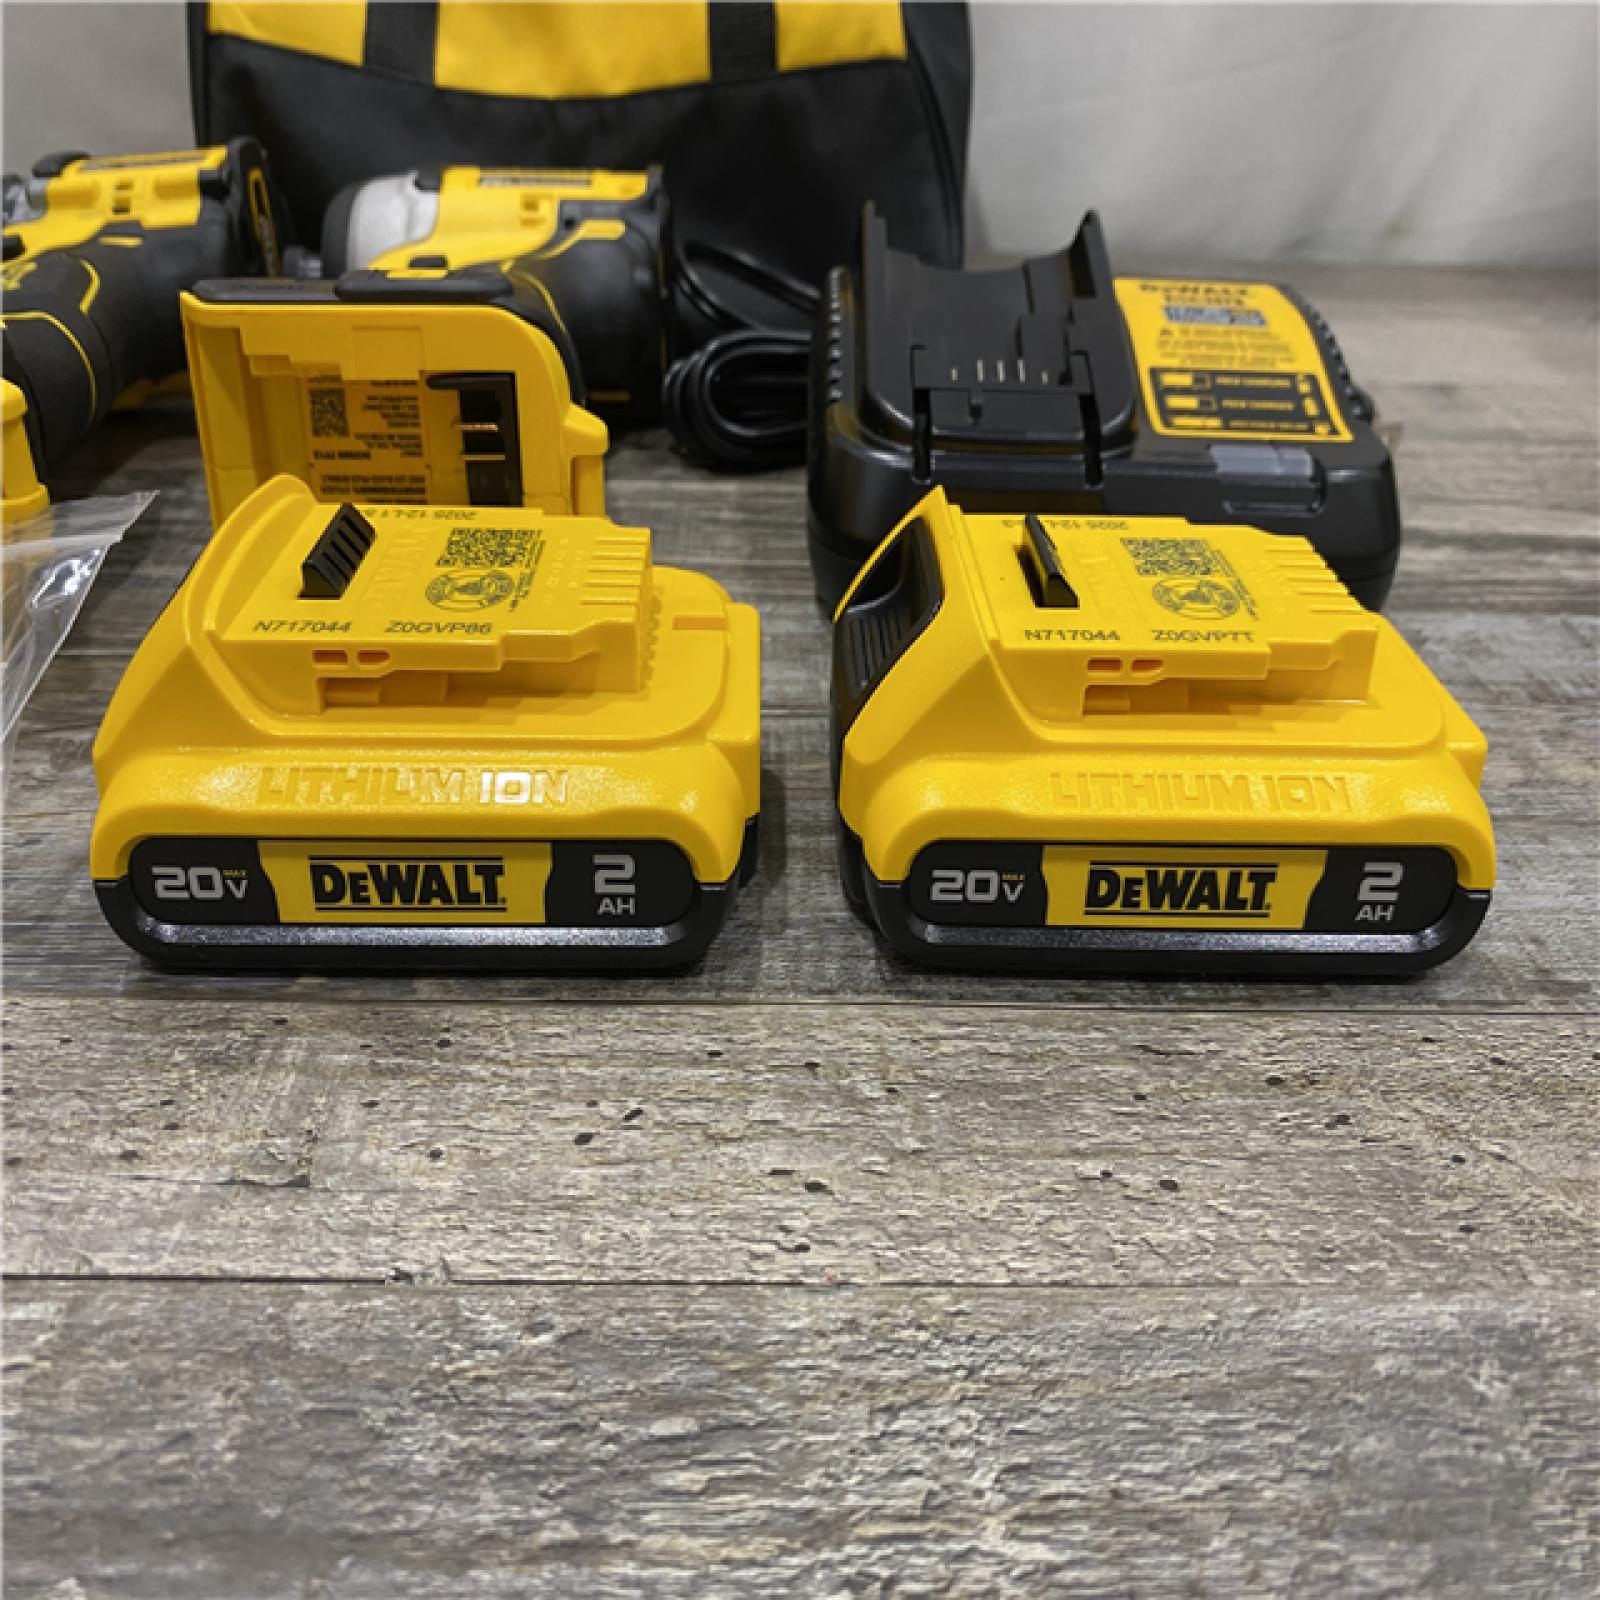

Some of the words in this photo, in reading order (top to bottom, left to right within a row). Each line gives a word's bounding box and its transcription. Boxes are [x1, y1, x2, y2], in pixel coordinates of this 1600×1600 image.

[252, 619, 352, 632] N717044
[1024, 629, 1121, 641] N717044
[255, 766, 466, 804] LITHIUM
[480, 768, 569, 804] ION
[1050, 773, 1251, 811] LITHIUM
[1258, 774, 1351, 812] ION
[592, 854, 636, 896] 2
[1358, 861, 1403, 903] 2
[596, 897, 636, 916] AH
[1354, 904, 1394, 922] AH
